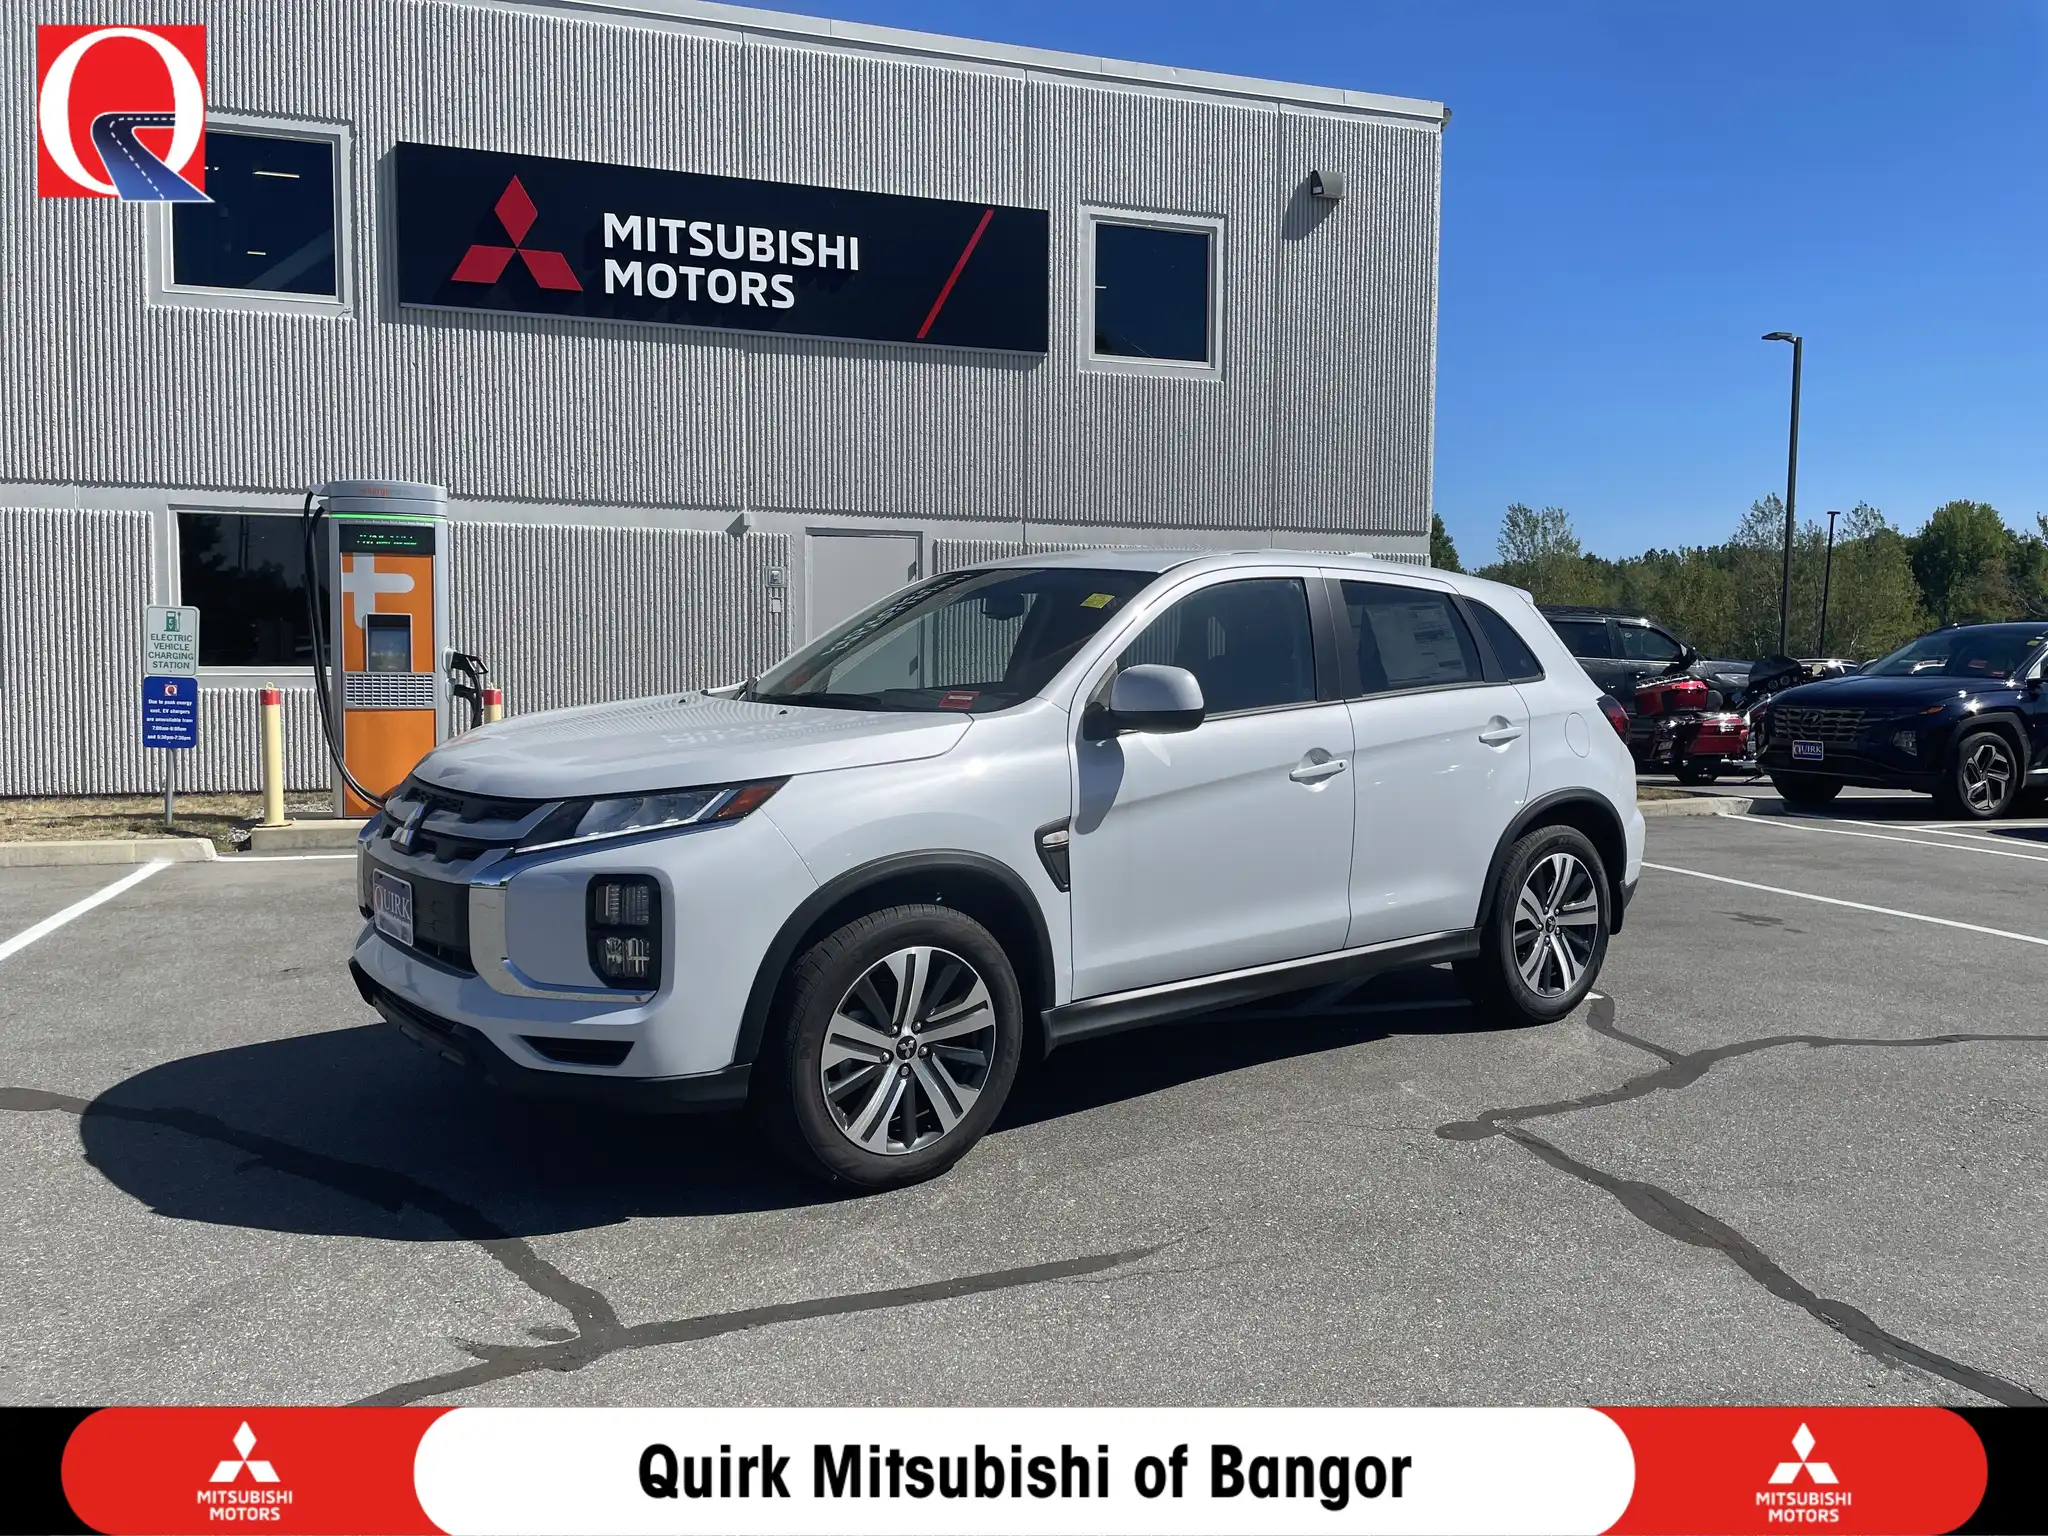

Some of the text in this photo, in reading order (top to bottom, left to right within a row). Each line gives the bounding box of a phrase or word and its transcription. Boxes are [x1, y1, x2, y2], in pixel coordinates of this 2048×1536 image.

[603, 212, 859, 271] MITSUBISHI
[604, 258, 795, 309] MOTORS
[150, 633, 193, 642] ELECTRIC
[153, 642, 190, 651] VEHICLE
[148, 651, 194, 660] CHARGING
[152, 660, 190, 669] STATION
[1793, 744, 1822, 755] QUIRK
[374, 886, 410, 920] QUIRK
